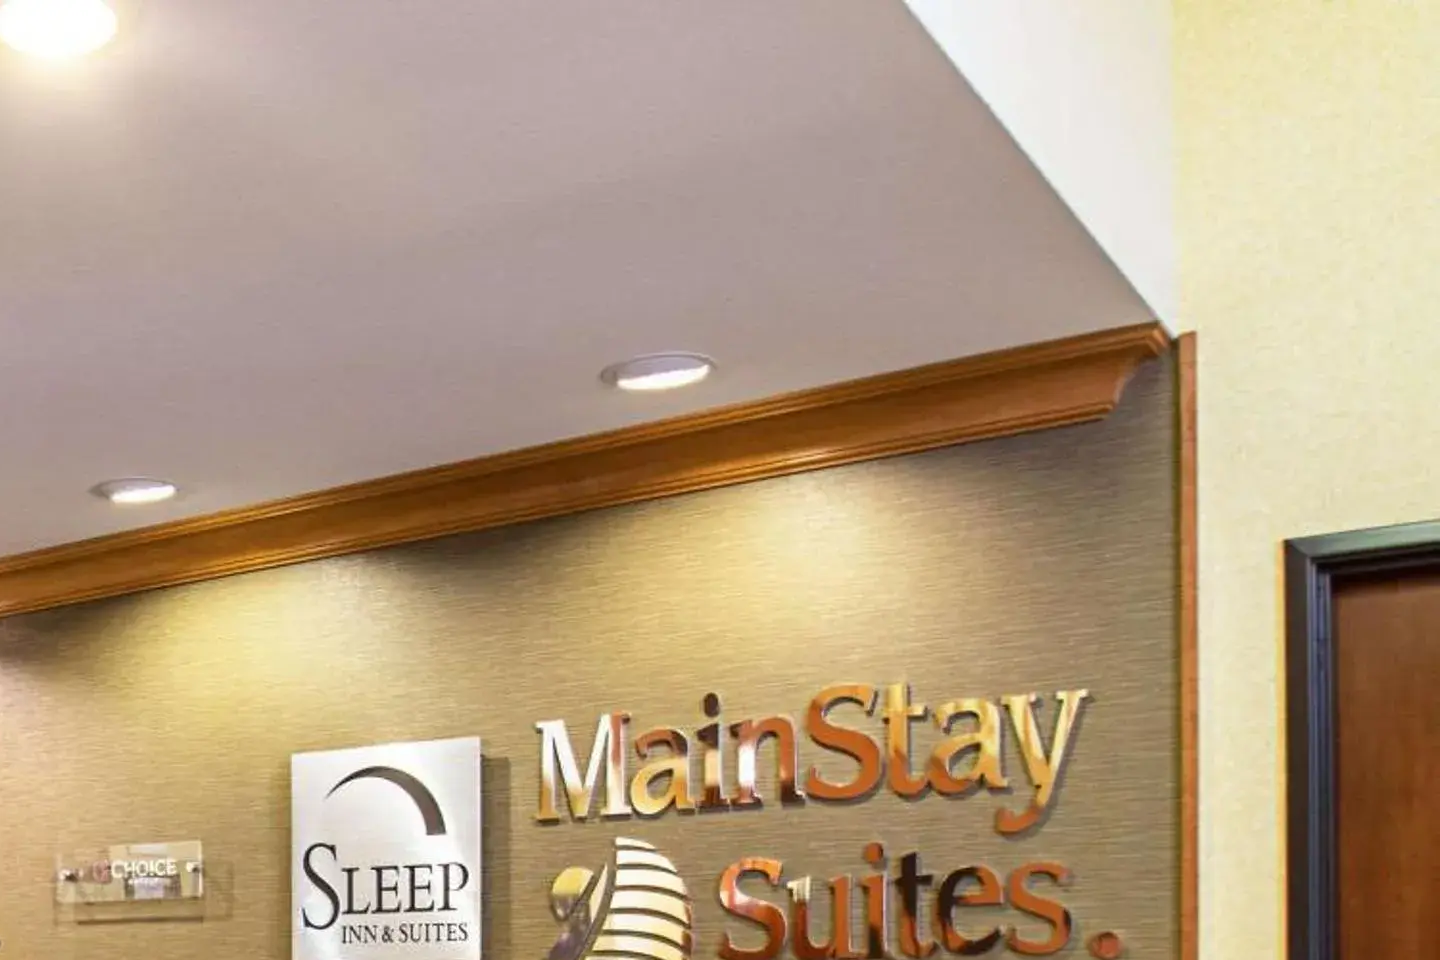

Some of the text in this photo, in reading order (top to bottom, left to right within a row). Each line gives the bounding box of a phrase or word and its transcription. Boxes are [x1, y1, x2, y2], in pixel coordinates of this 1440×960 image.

[533, 682, 1088, 835] MainStay
[112, 859, 177, 879] CHOICE
[302, 843, 469, 930] SLEEP
[342, 922, 469, 944] INN & SUITES
